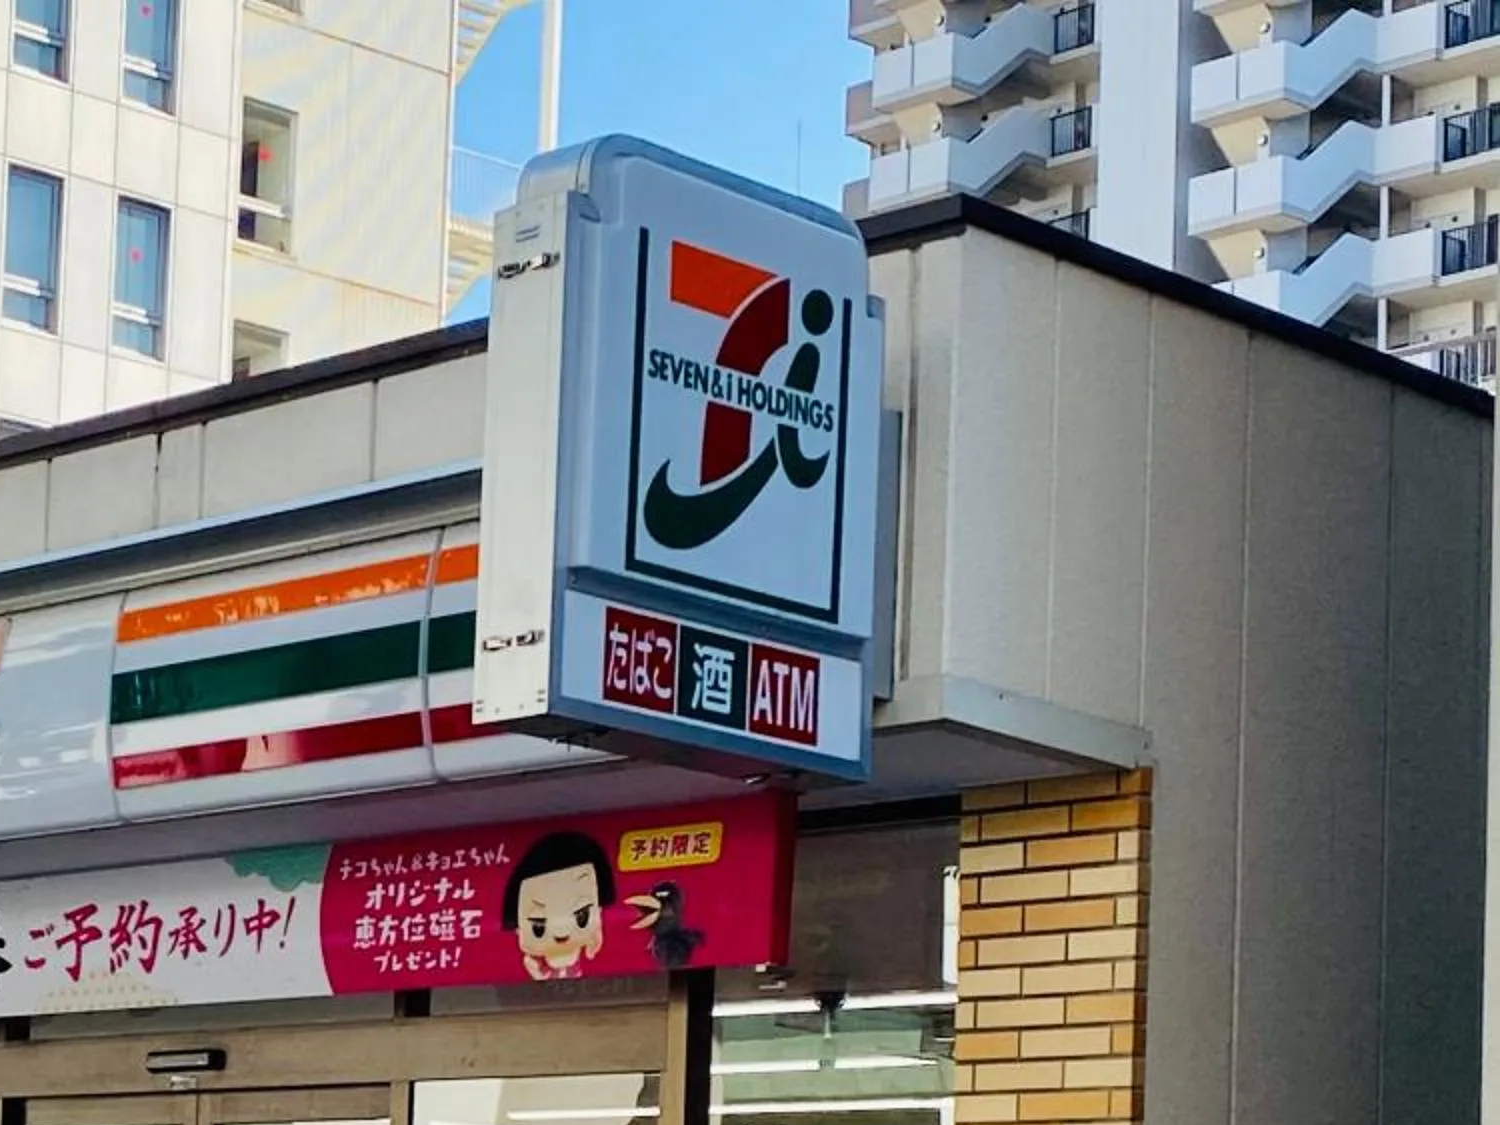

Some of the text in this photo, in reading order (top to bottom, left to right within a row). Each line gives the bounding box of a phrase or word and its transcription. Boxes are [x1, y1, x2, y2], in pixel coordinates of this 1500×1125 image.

[737, 378, 835, 433] HOLDINGS
[607, 622, 673, 700] たばこ
[691, 643, 732, 716] 酒
[752, 659, 817, 734] ATM
[630, 831, 711, 861] 予約限定
[364, 876, 476, 910] オリジナル
[373, 947, 461, 974] プレゼント!
